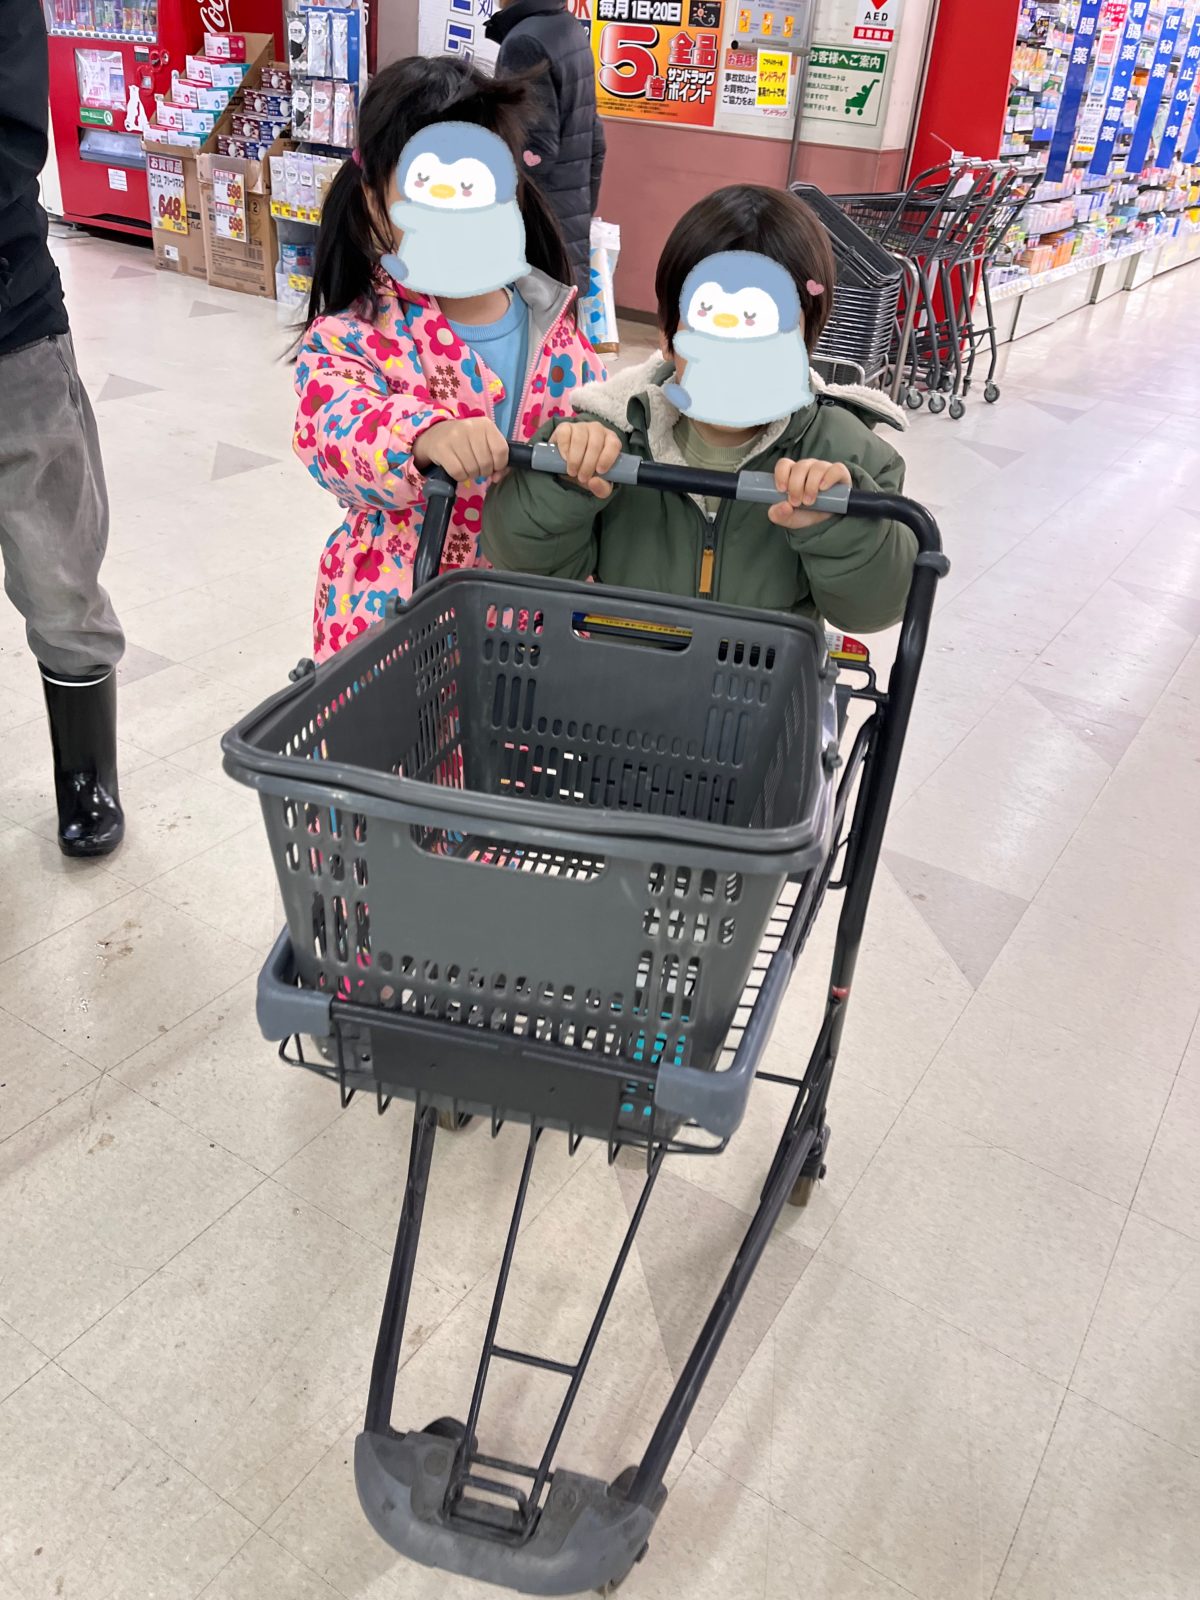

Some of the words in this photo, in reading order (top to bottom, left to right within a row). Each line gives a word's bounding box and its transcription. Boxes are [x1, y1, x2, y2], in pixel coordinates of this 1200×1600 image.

[864, 11, 889, 21] AED
[668, 31, 718, 68] 全品
[1152, 15, 1180, 78] 便秘薬
[809, 50, 881, 70] お客様へご案内
[667, 67, 715, 85] サンドラッグ
[667, 81, 712, 104] ポイント
